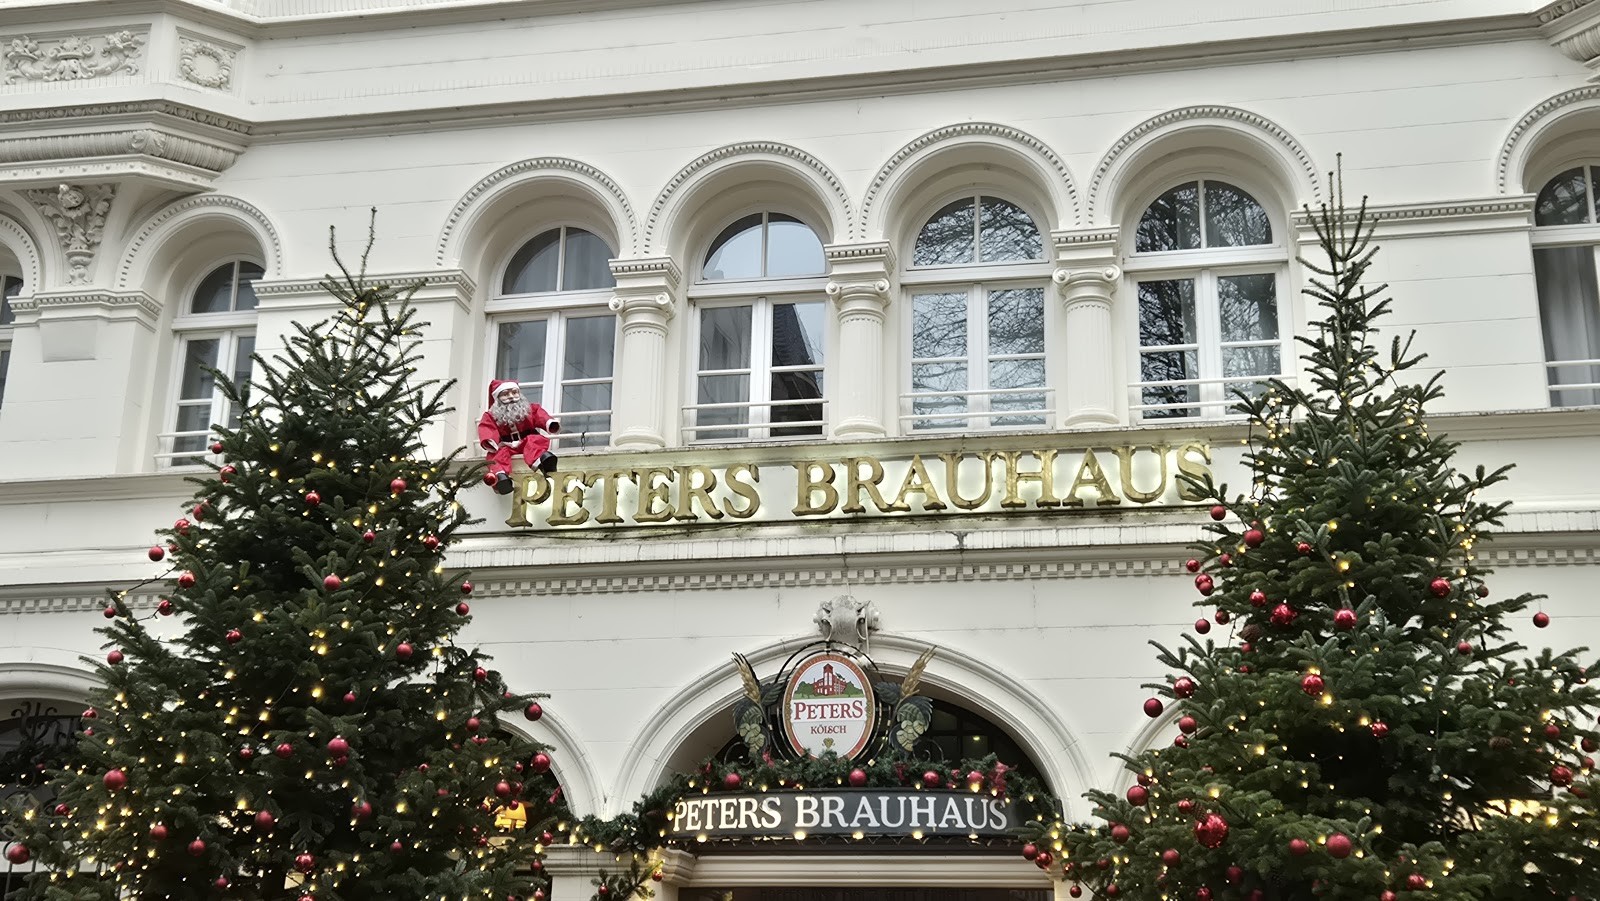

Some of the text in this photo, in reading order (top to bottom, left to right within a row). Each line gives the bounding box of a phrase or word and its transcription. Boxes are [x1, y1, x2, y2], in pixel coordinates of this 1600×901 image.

[505, 441, 1213, 528] PETERS BRAUHAUS
[794, 700, 863, 720] PETERS
[810, 724, 847, 735] KÖLSCH
[672, 795, 1008, 832] PETERS BRAUHAUS
